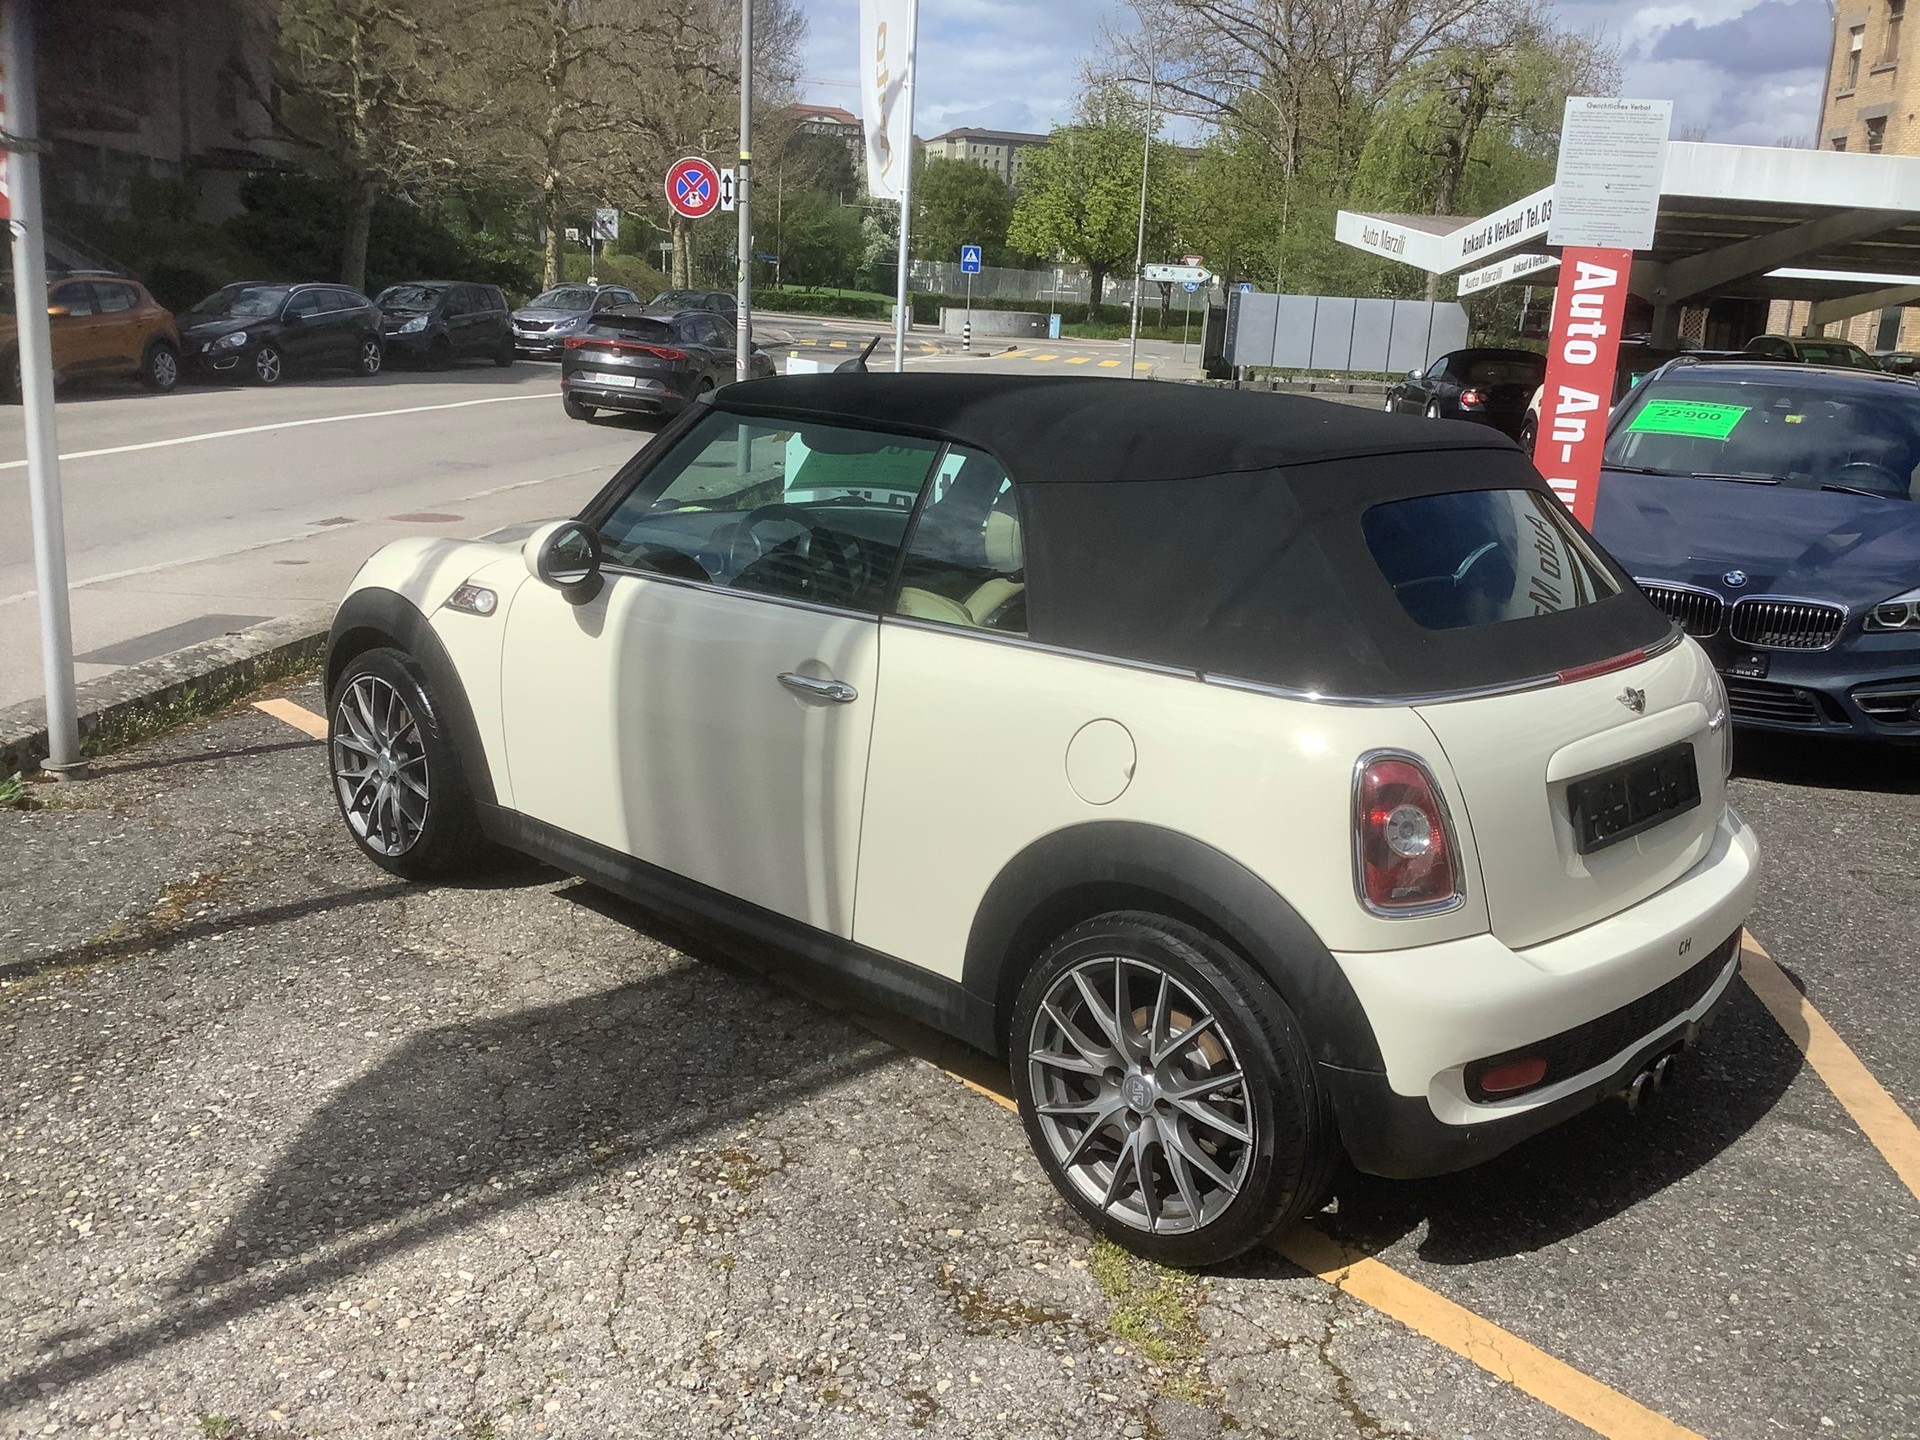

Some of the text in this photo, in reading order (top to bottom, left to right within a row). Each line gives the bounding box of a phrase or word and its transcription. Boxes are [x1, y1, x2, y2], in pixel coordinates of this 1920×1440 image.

[1630, 103, 1651, 111] Verbot
[1362, 225, 1406, 255] Auto Marzili
[1462, 231, 1486, 256] Ankauf
[1487, 226, 1493, 244] &
[1494, 211, 1524, 243] Verkauf
[1526, 207, 1540, 230] Tel.
[1465, 272, 1480, 290] Auto
[1513, 258, 1528, 274] Ankauf
[1563, 260, 1618, 365] Auto
[1552, 385, 1600, 463] An-
[1655, 409, 1722, 421] 22'900
[1678, 937, 1692, 956] CH
